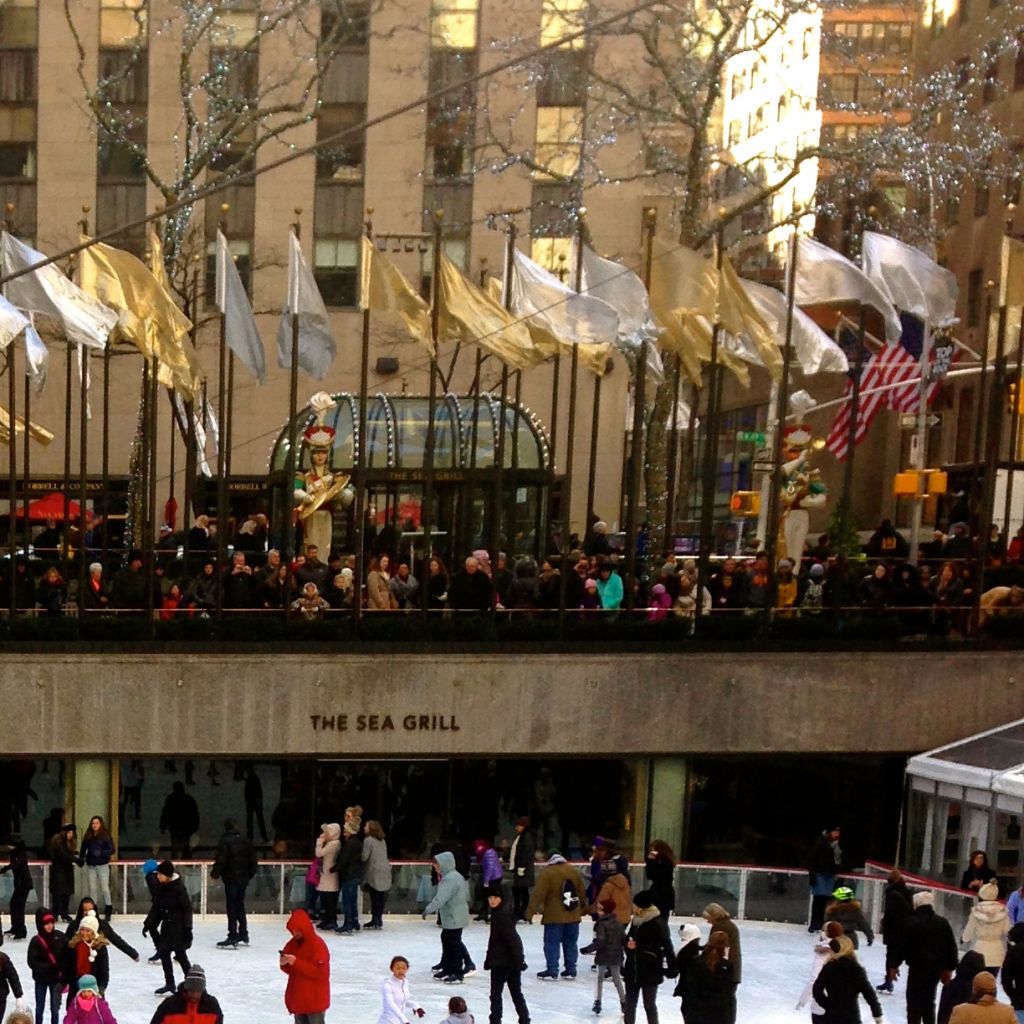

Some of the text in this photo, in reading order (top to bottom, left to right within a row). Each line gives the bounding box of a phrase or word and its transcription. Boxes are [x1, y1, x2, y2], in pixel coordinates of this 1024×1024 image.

[936, 345, 953, 360] TOP
[390, 471, 408, 481] THE
[435, 471, 465, 481] GRILL
[22, 482, 59, 491] ORRELL
[310, 714, 461, 731] THE SEA GRILL
